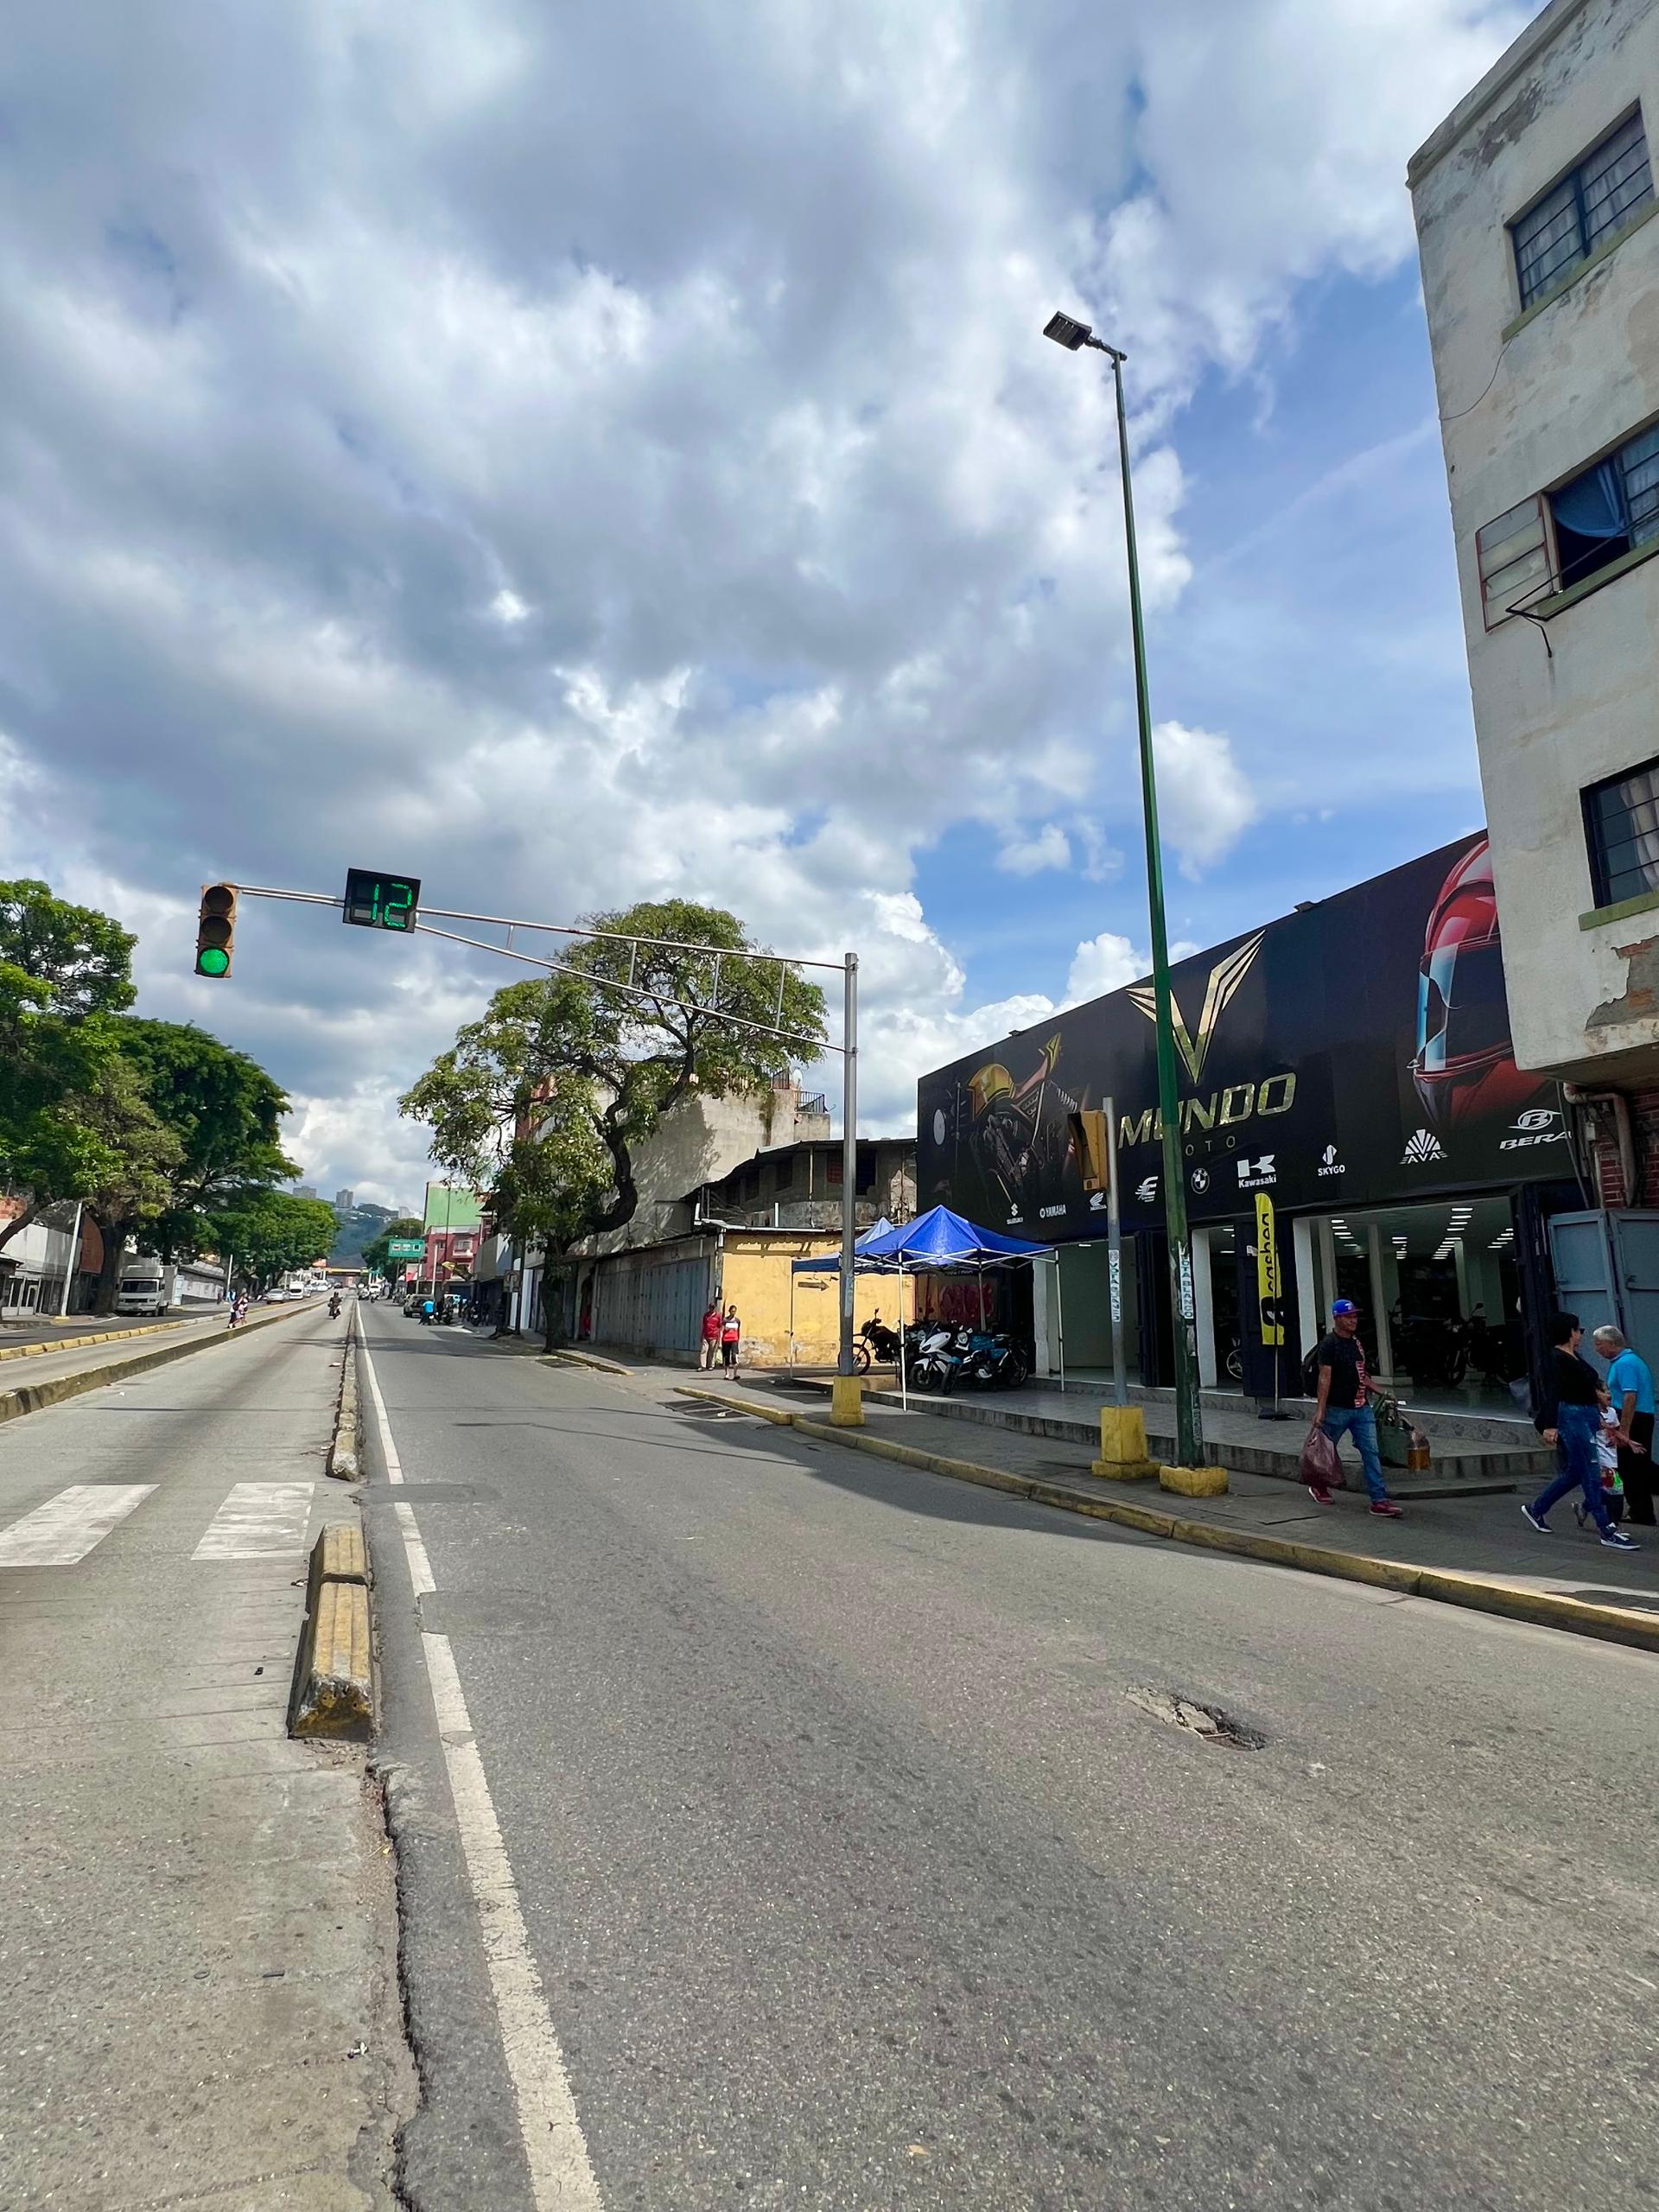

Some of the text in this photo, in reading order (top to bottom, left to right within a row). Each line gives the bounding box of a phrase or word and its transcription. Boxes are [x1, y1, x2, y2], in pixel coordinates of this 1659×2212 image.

[371, 882, 413, 928] 12
[1185, 1135, 1236, 1156] OTO
[1499, 1130, 1572, 1150] BERA
[1407, 1151, 1441, 1164] AVA
[1317, 1164, 1345, 1176] SKYGO
[1238, 1173, 1277, 1188] Kawasaki
